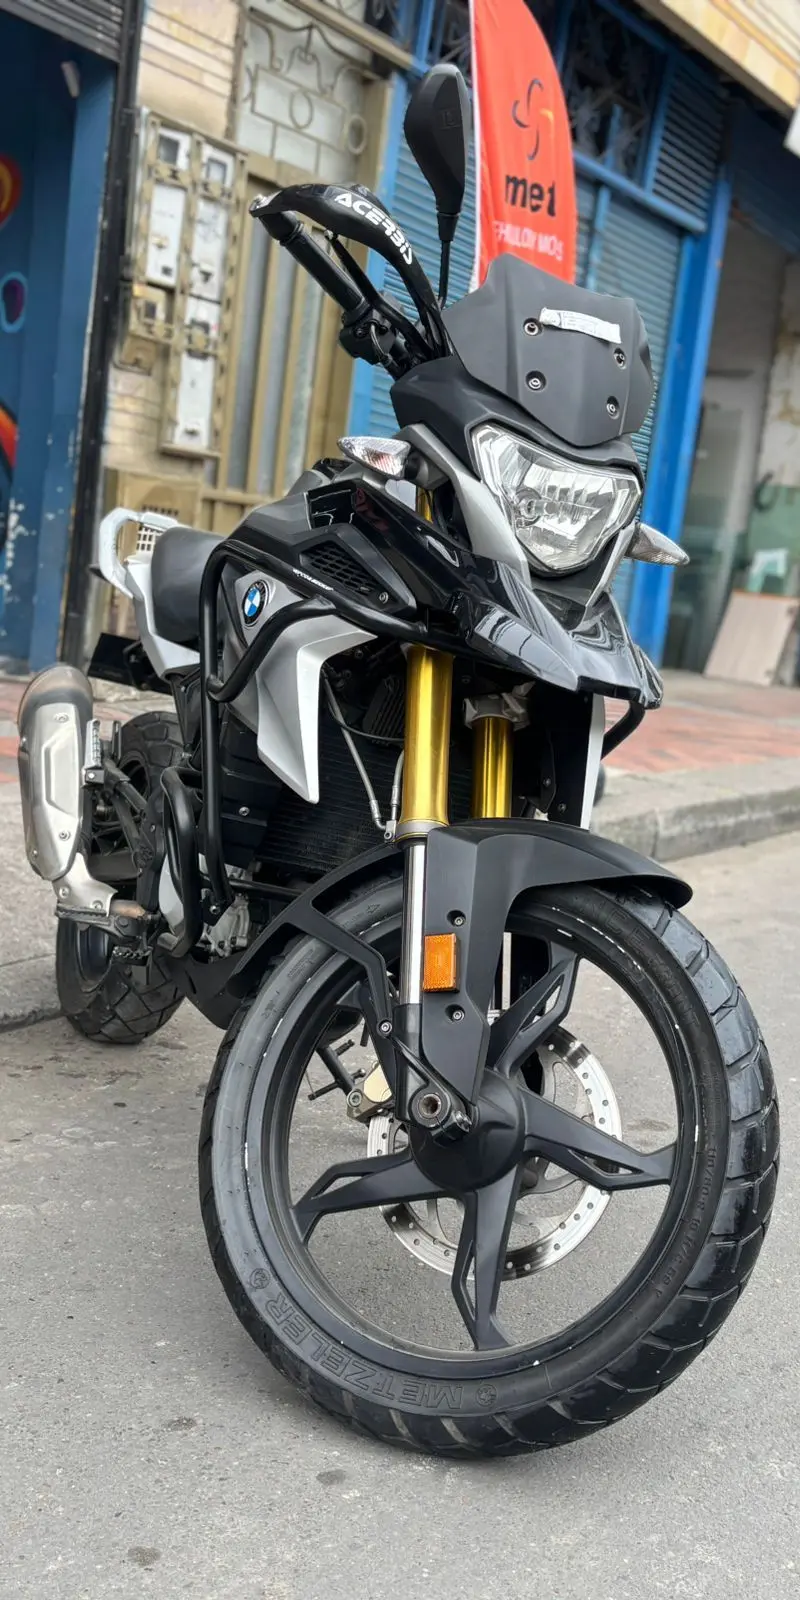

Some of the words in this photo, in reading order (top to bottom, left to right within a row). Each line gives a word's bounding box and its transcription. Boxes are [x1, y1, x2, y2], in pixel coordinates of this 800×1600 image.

[334, 192, 413, 265] ACERBIS
[504, 173, 556, 217] met
[263, 1291, 465, 1410] METZELER
